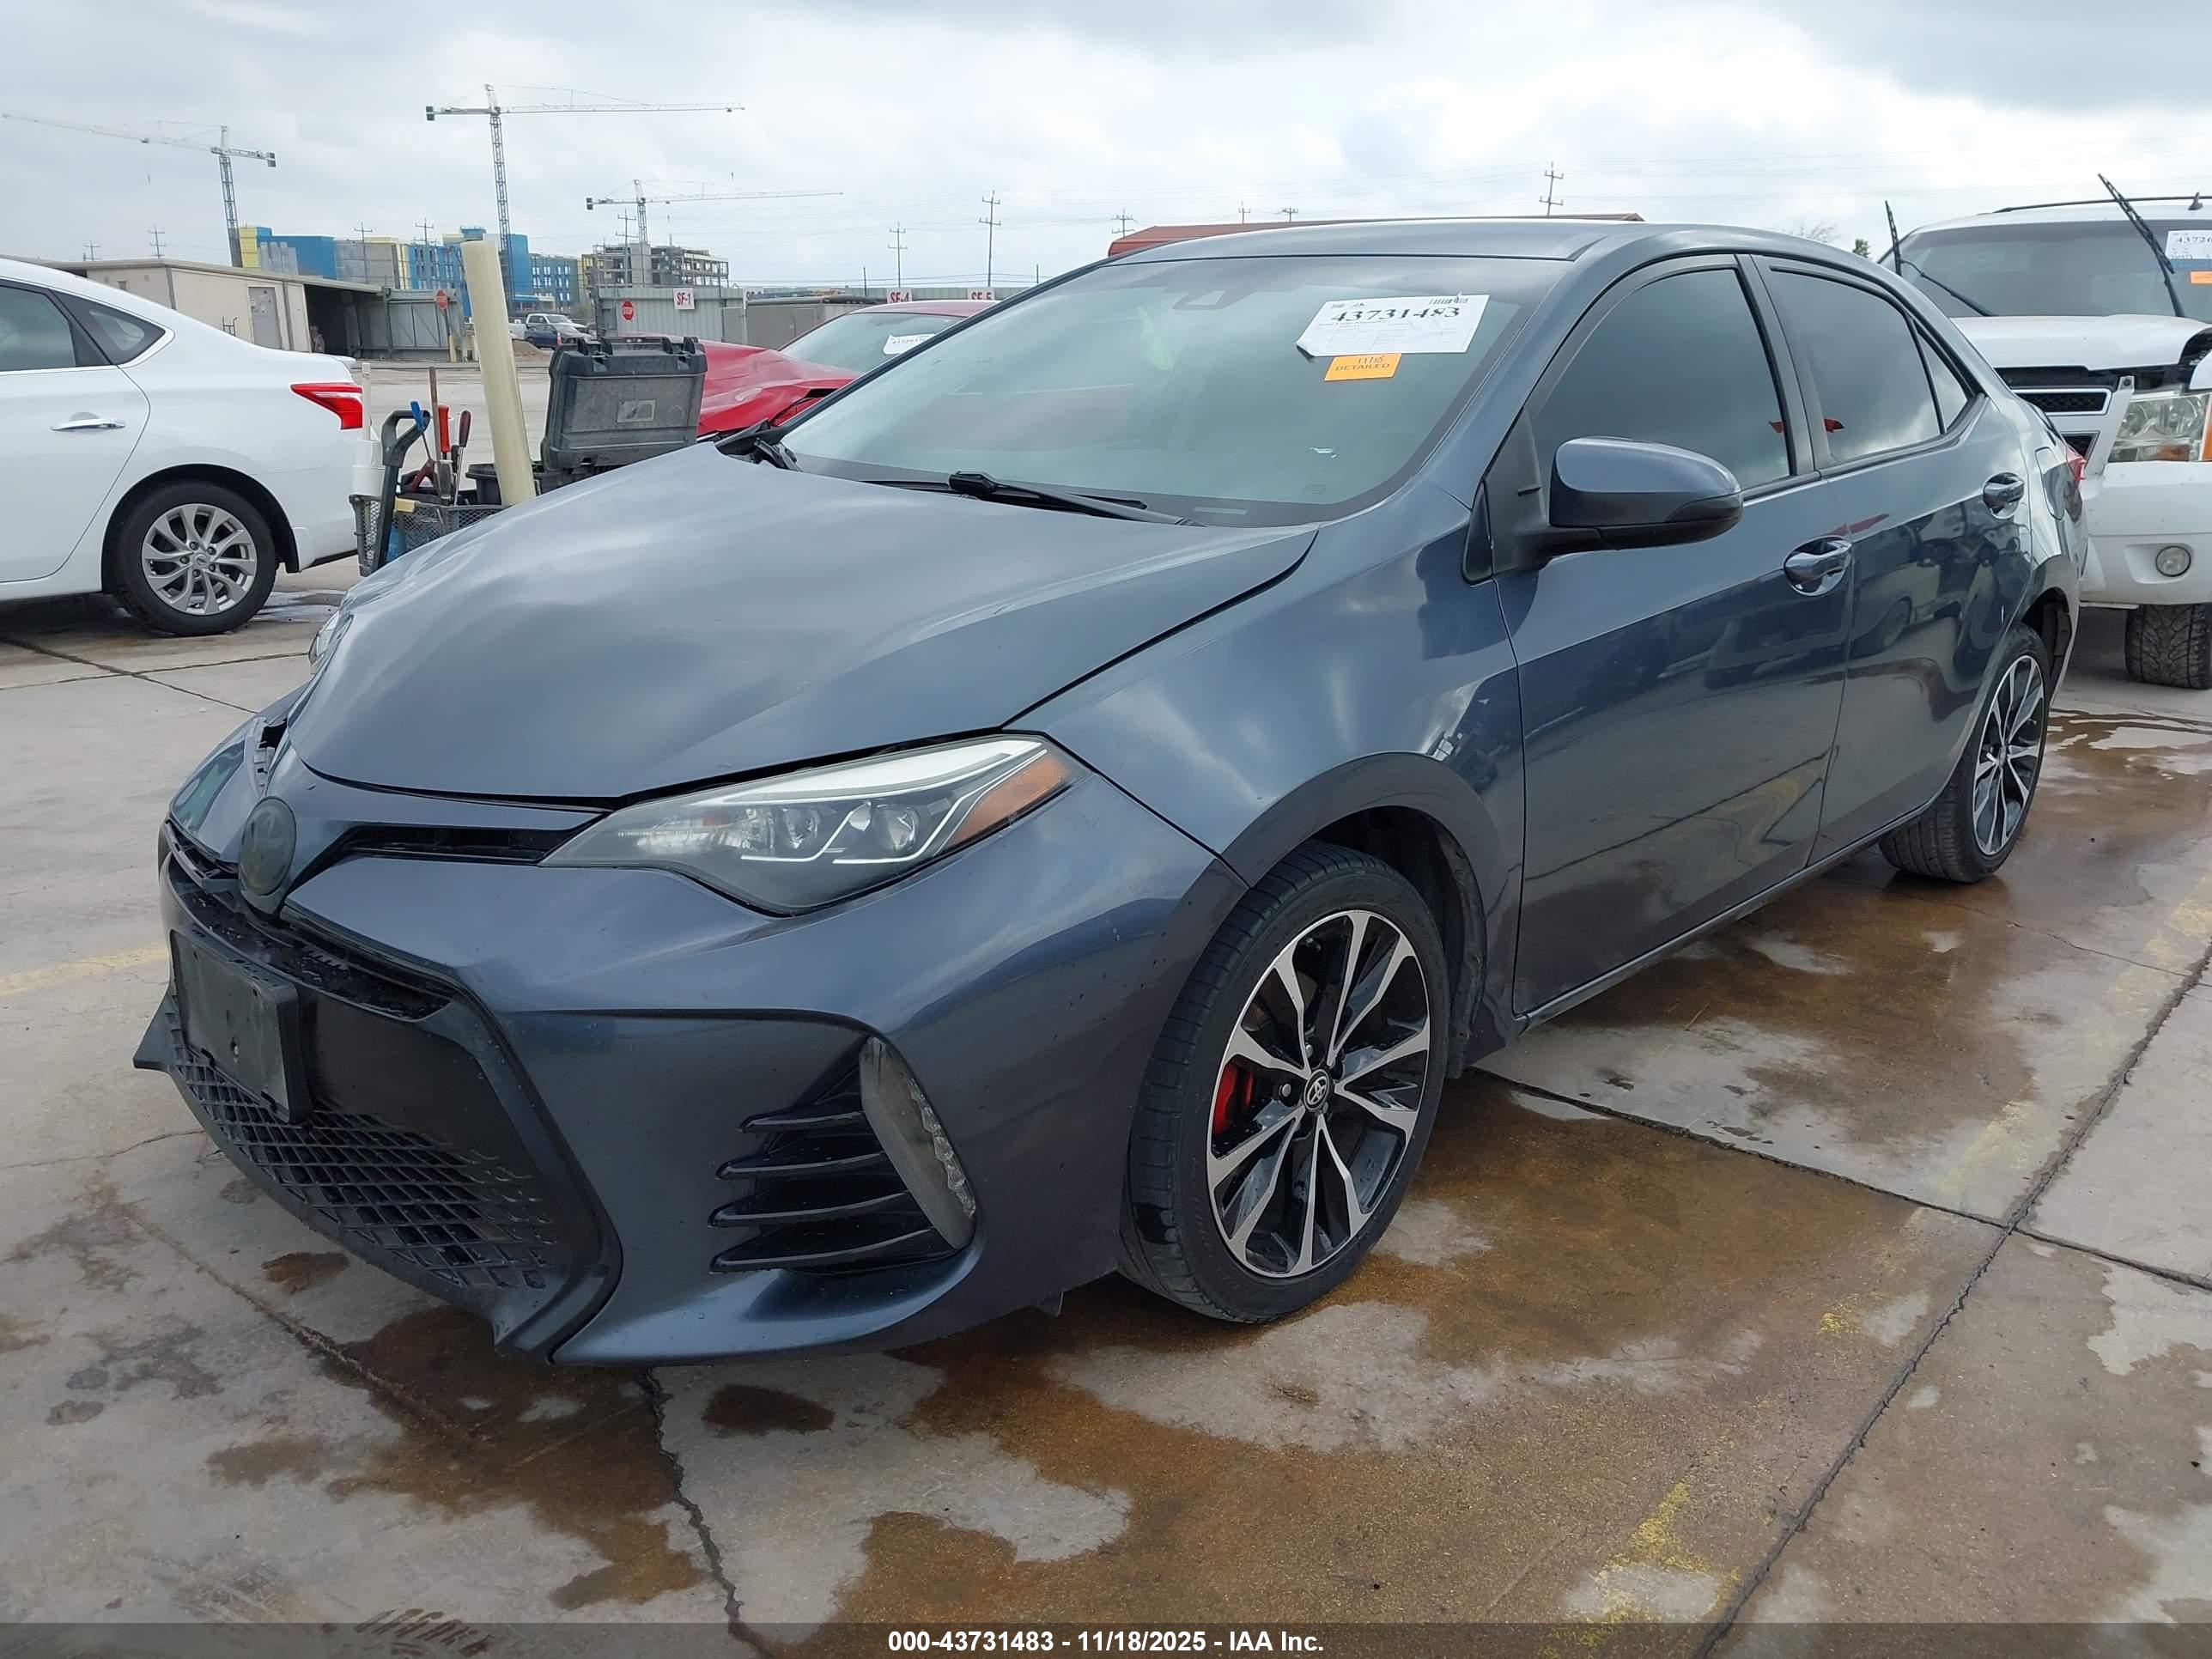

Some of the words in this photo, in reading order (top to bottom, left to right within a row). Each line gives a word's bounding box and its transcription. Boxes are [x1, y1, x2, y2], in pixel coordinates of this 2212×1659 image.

[677, 292, 691, 306] SF-1
[971, 291, 992, 301] SF5
[623, 307, 634, 315] STOP
[1331, 307, 1461, 322] 43731483
[1335, 362, 1390, 371] DETAILED
